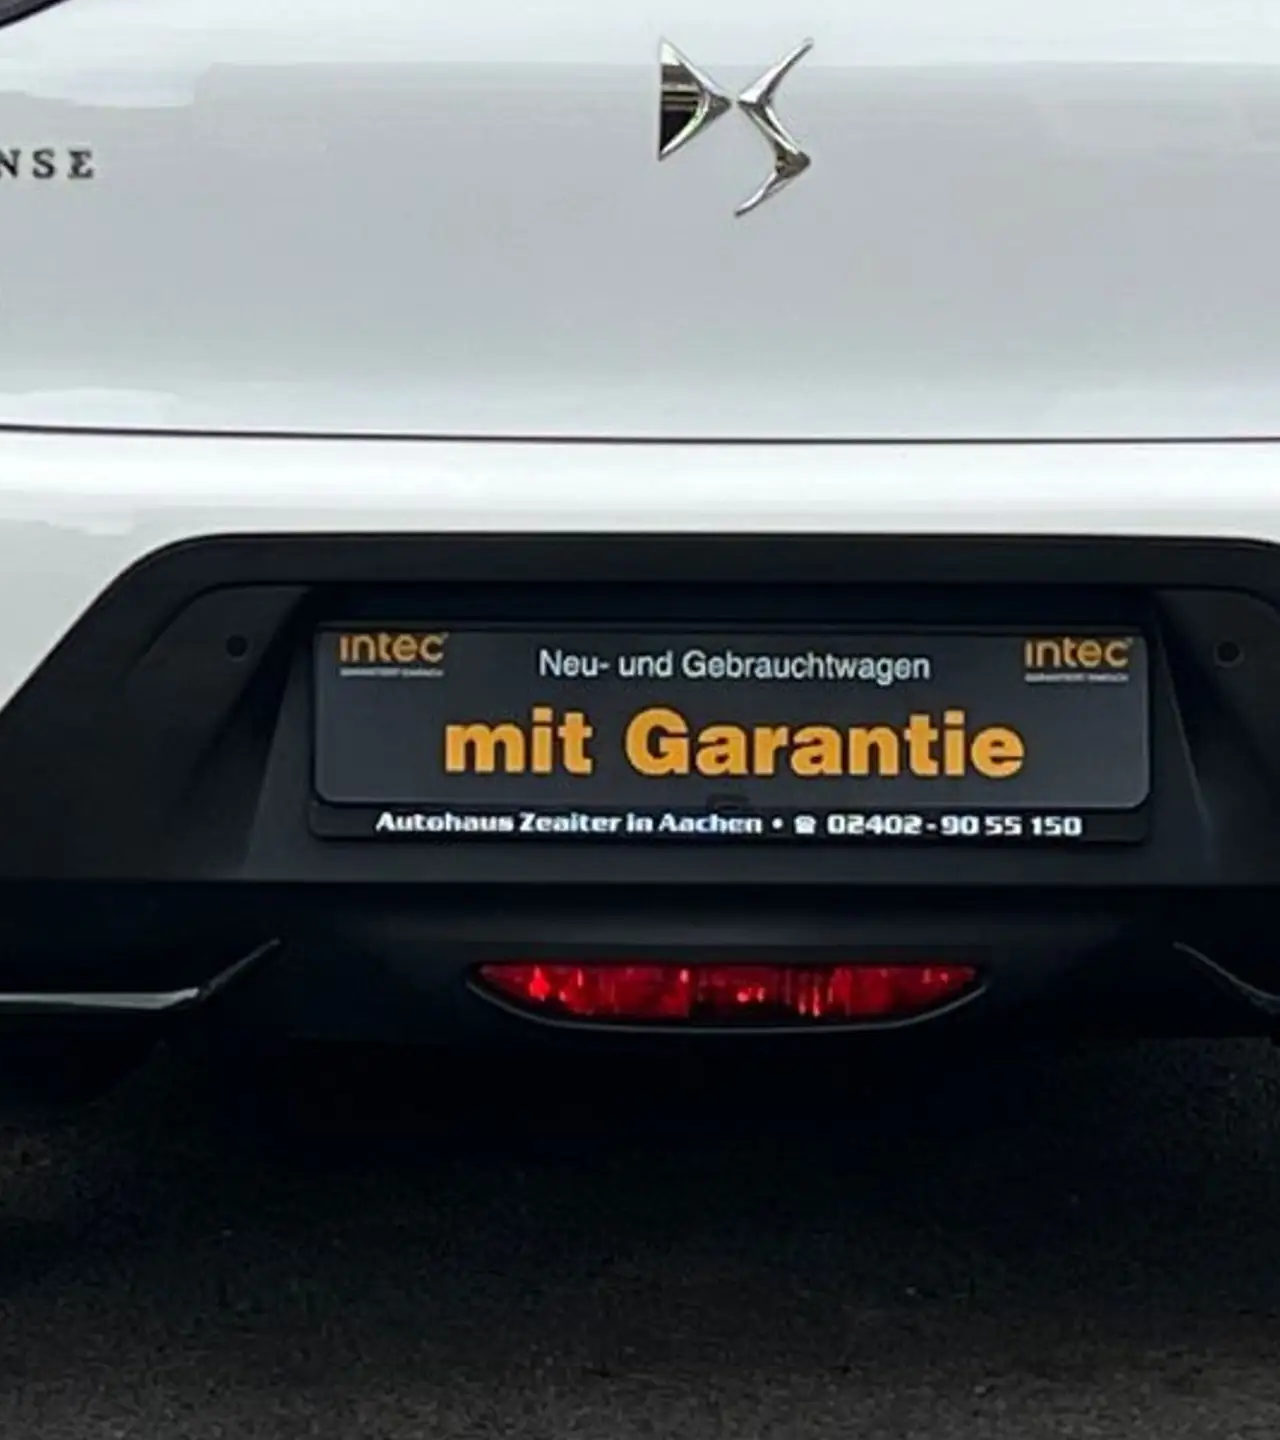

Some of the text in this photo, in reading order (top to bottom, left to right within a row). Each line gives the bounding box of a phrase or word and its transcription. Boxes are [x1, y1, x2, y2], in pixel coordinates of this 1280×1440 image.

[338, 632, 444, 662] intec
[1024, 637, 1130, 668] intec
[538, 649, 931, 686] Neu- und Gebrauchtwagen
[444, 707, 1026, 778] mit Garantie
[375, 811, 515, 833] Autohaus
[658, 813, 763, 835] Aachen
[1031, 815, 1083, 837] 150
